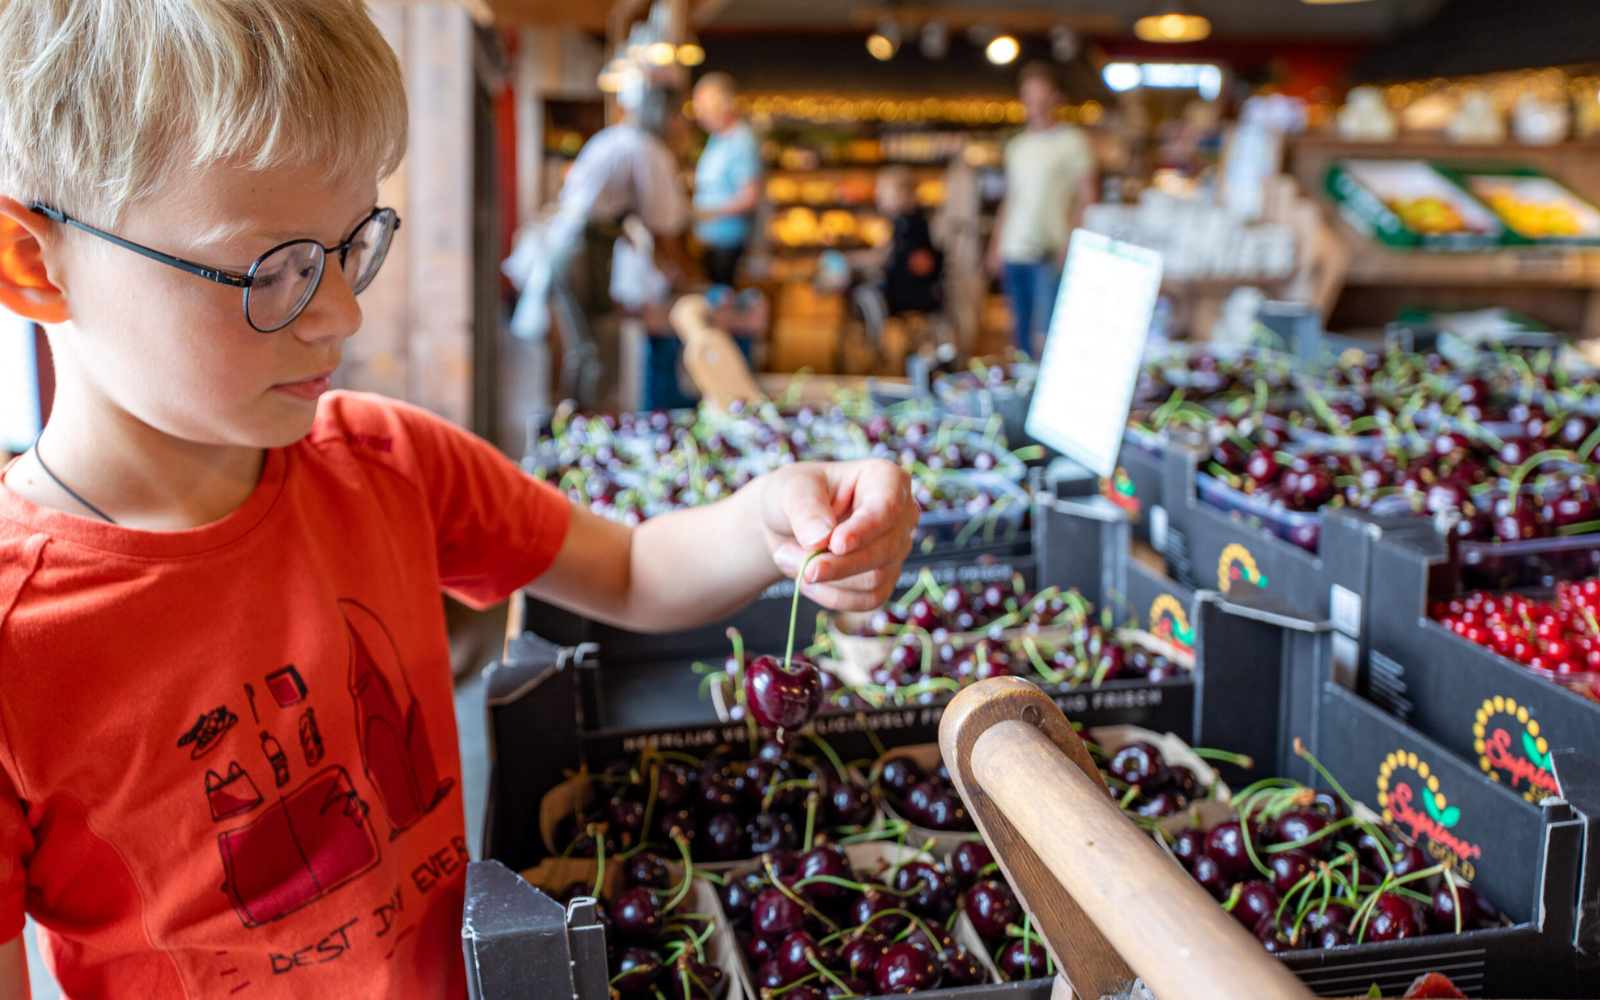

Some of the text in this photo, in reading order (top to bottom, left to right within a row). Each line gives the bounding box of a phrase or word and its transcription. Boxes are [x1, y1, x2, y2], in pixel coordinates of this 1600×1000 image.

[623, 729, 718, 752] HEERLIJK
[804, 710, 915, 735] ELICIOUSLY
[1091, 688, 1162, 711] FRISCH
[269, 917, 359, 975] BEST
[411, 836, 469, 893] EVER
